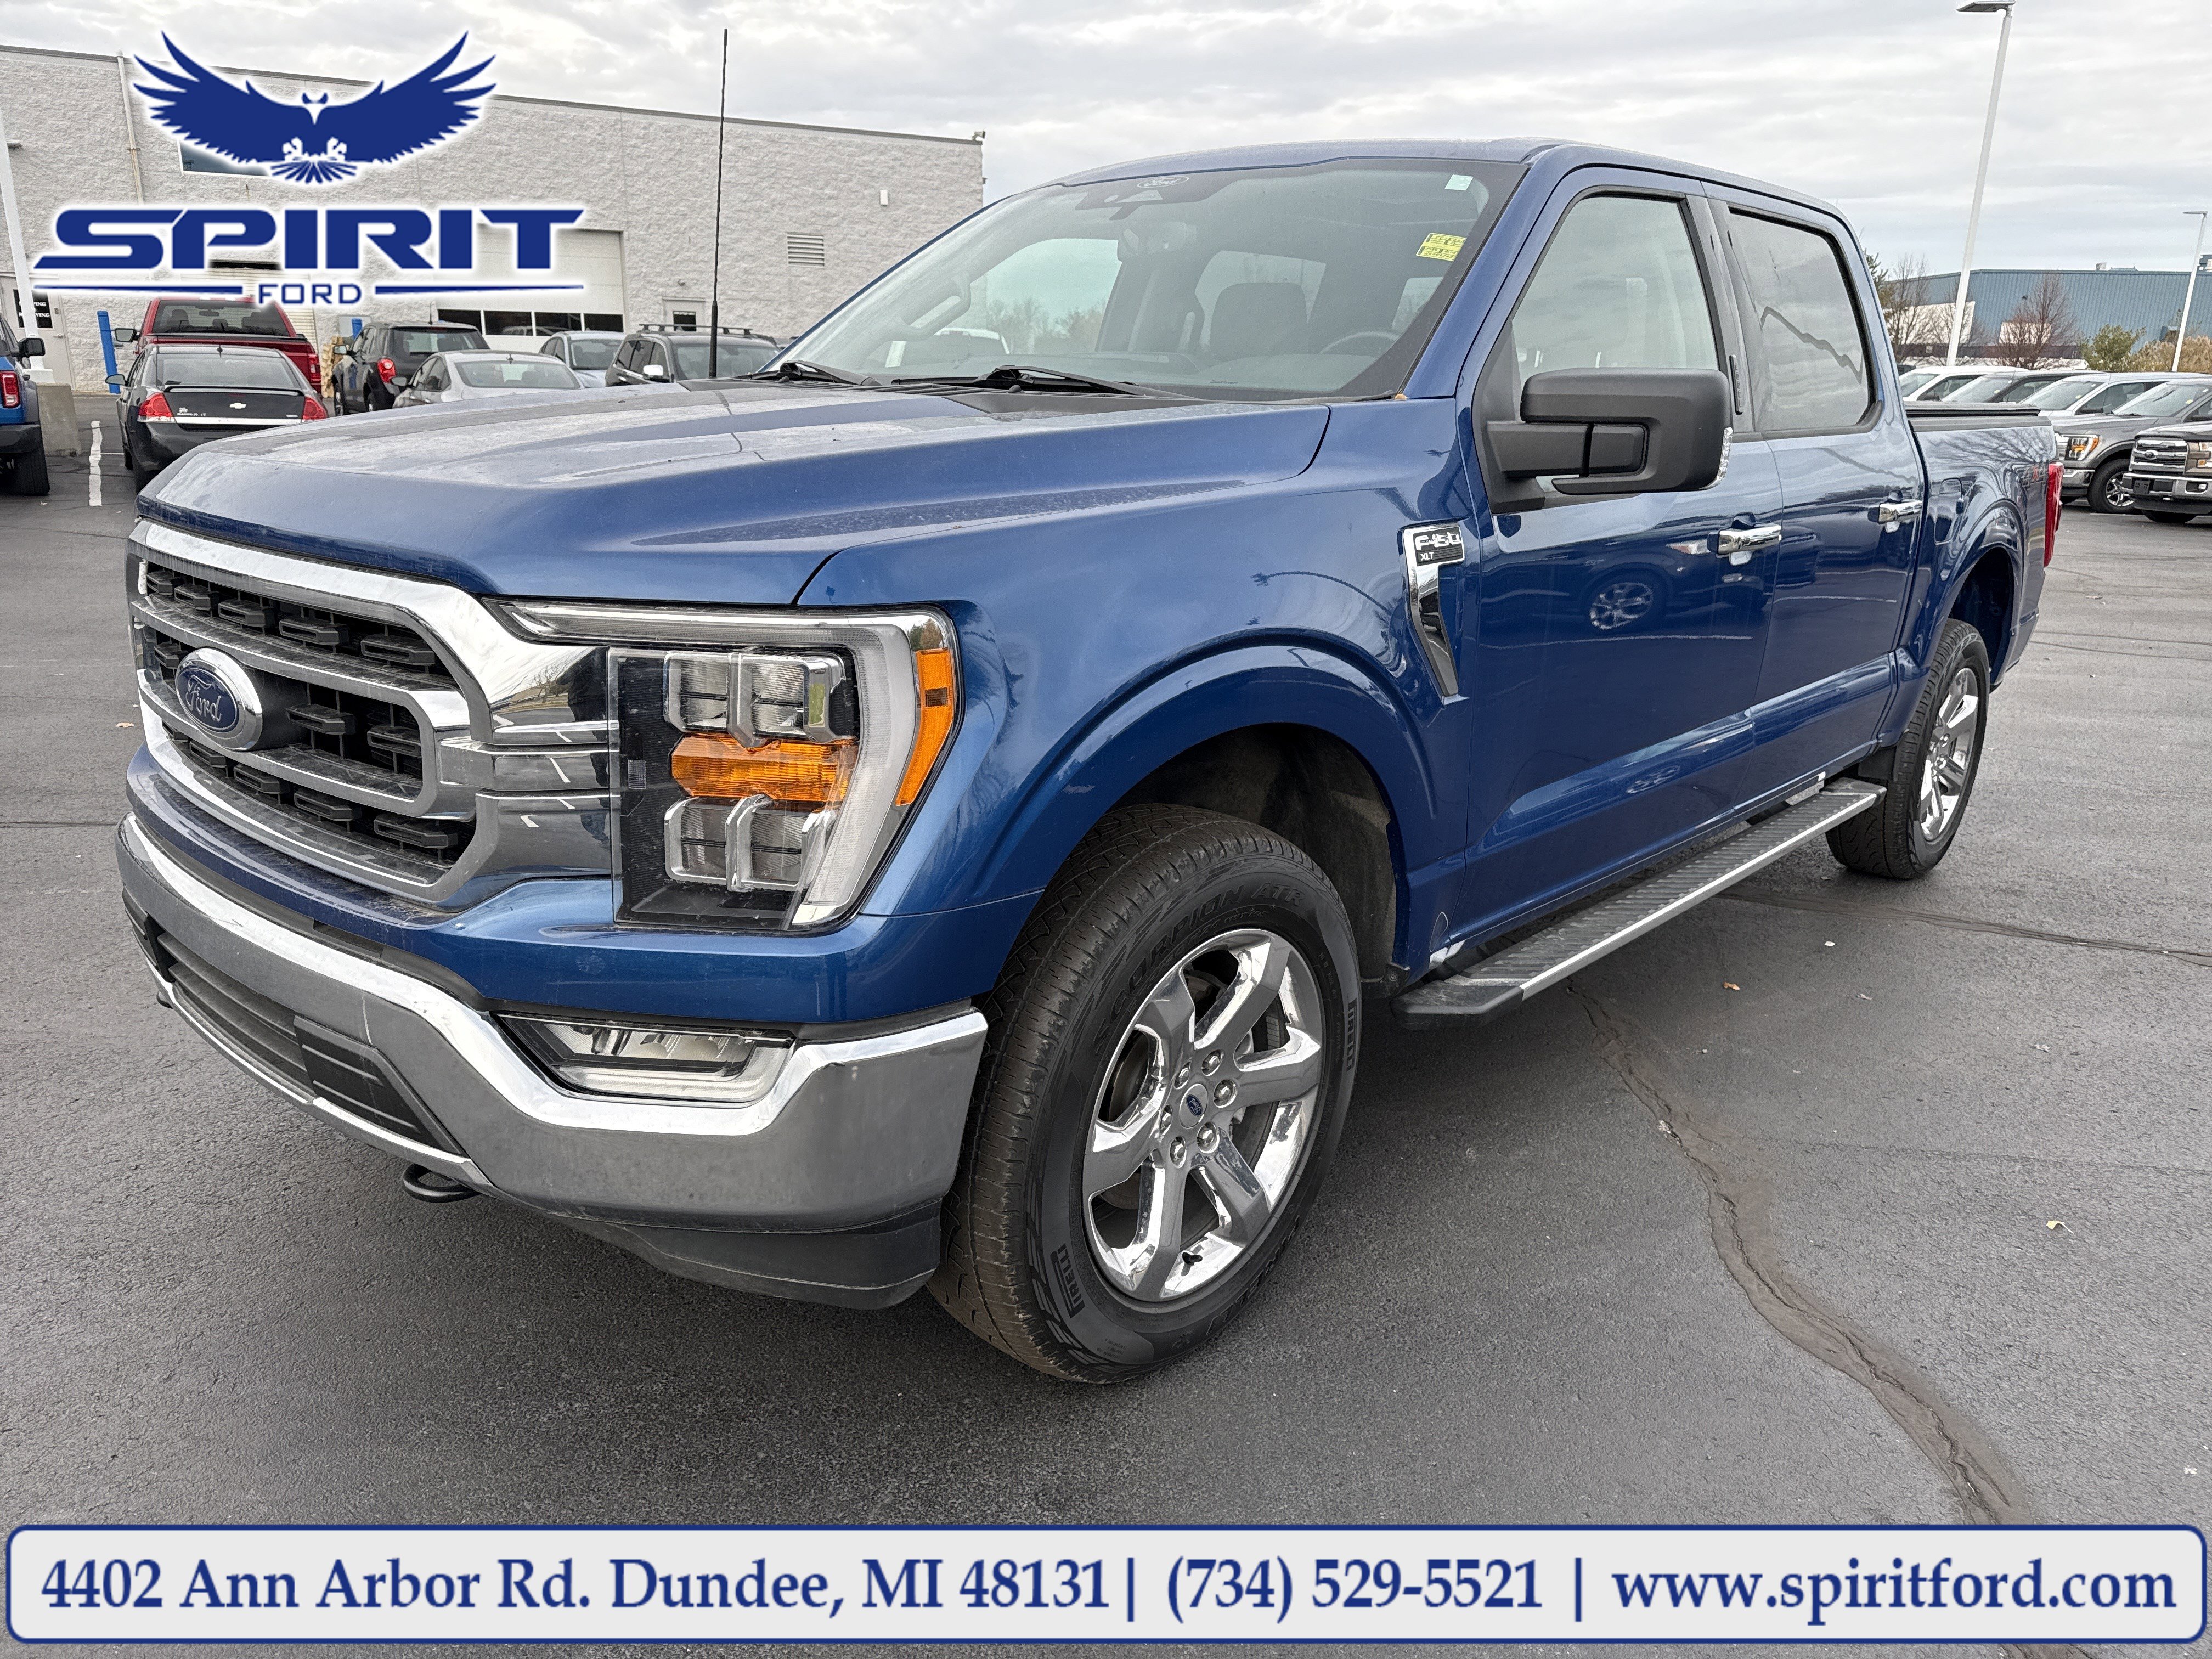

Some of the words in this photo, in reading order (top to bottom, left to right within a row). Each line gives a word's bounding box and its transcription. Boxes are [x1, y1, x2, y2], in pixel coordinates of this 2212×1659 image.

[1415, 532, 1462, 550] F-150
[1420, 551, 1434, 561] XLT
[185, 675, 222, 723] Ford
[1250, 881, 1306, 908] ATR
[1188, 1097, 1201, 1114] Ford
